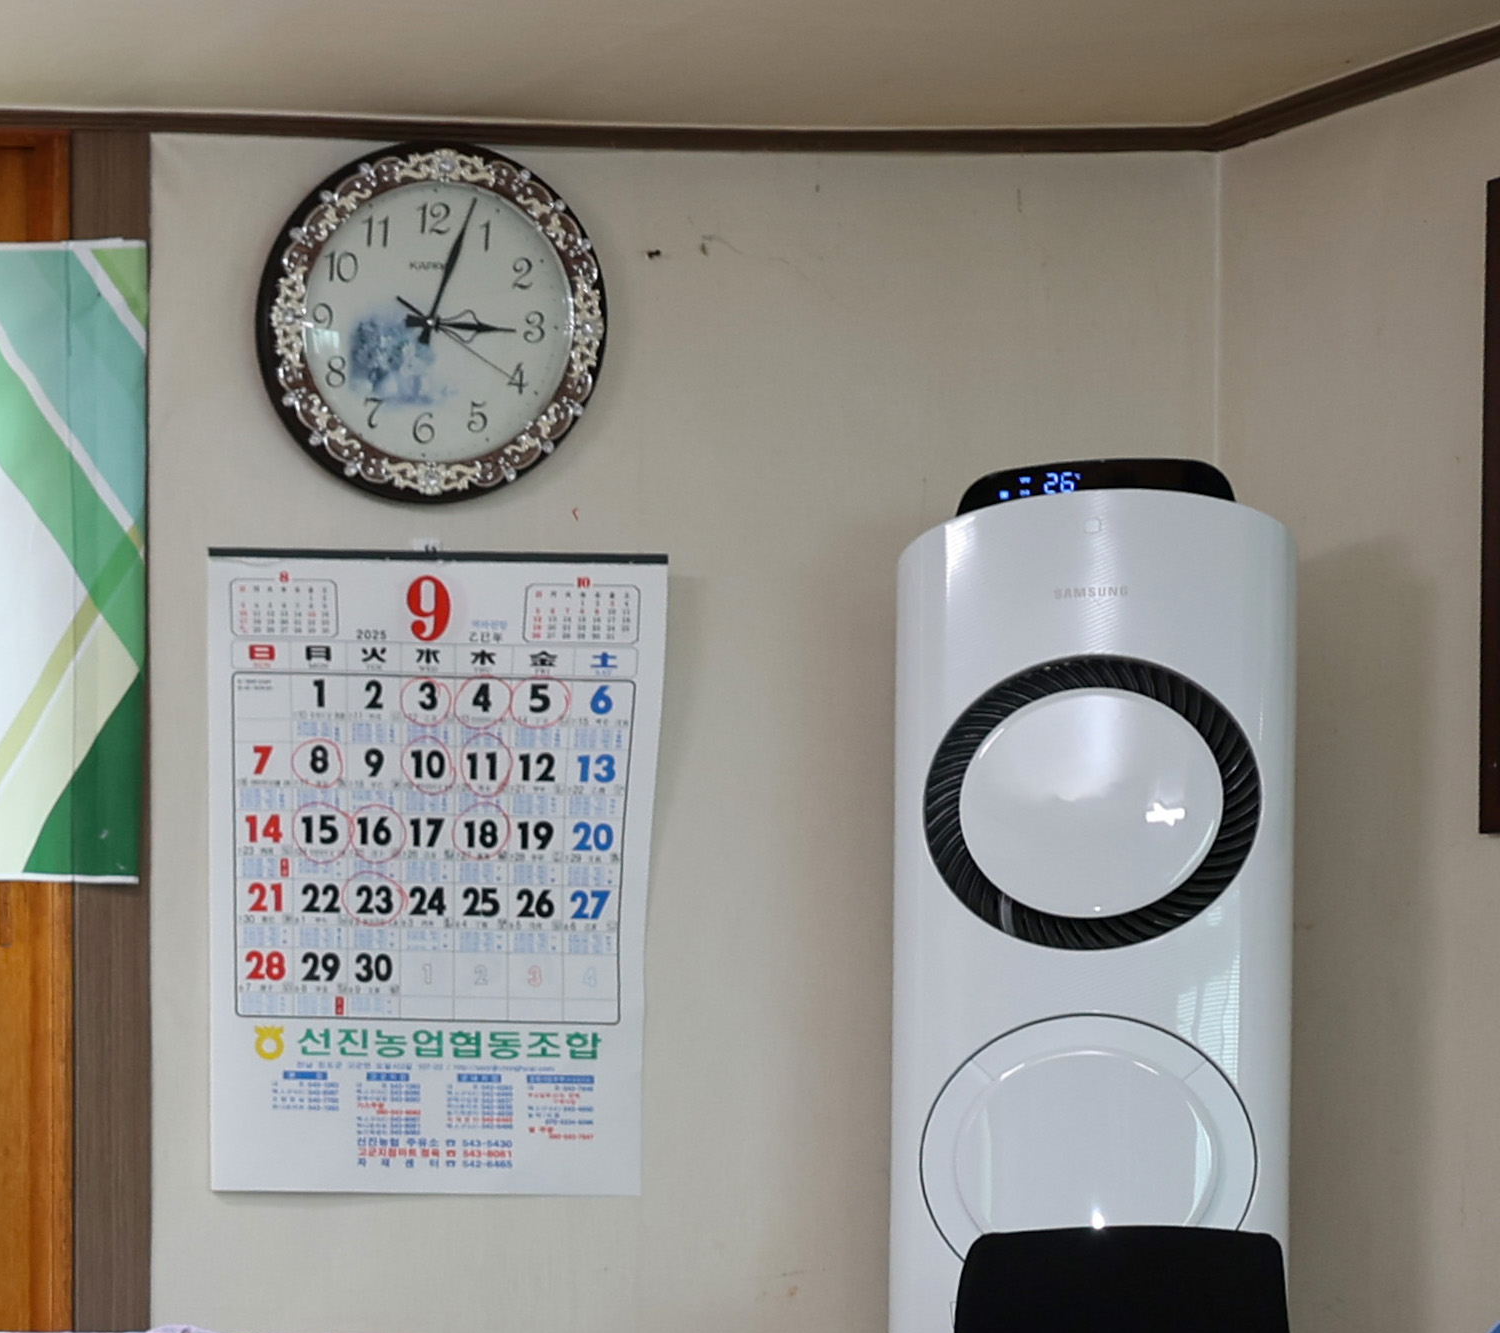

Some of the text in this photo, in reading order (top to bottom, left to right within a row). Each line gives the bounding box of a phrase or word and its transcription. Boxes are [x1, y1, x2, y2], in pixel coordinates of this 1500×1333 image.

[362, 215, 390, 248] 11
[416, 202, 451, 235] 12
[479, 219, 491, 251] 1
[325, 250, 359, 283] 10
[511, 257, 533, 290] 2
[312, 302, 334, 333] 9
[522, 310, 546, 344] 3
[325, 355, 346, 388] 8
[507, 362, 528, 395] 4
[363, 397, 383, 429] 7
[412, 412, 436, 444] 6
[466, 401, 488, 434] 5
[1043, 471, 1077, 495] 26
[576, 577, 591, 589] 10
[1053, 586, 1129, 600] SAMSUNG
[406, 574, 453, 642] 9
[356, 629, 388, 640] 2025
[249, 644, 618, 669] 日 月 火 水 木 金 土
[313, 679, 613, 715] 1 2 3 4 5 6
[253, 745, 616, 783] 7 8 9 10 11 12 13
[245, 814, 614, 851] 14 15 16 17 18 19 20
[248, 882, 611, 920] 21 22 23 24 25 26 27
[245, 950, 286, 981] 28
[301, 951, 341, 982] 29
[355, 953, 393, 983] 30
[527, 964, 543, 988] 3
[297, 1027, 603, 1060] 선진농업협동조합
